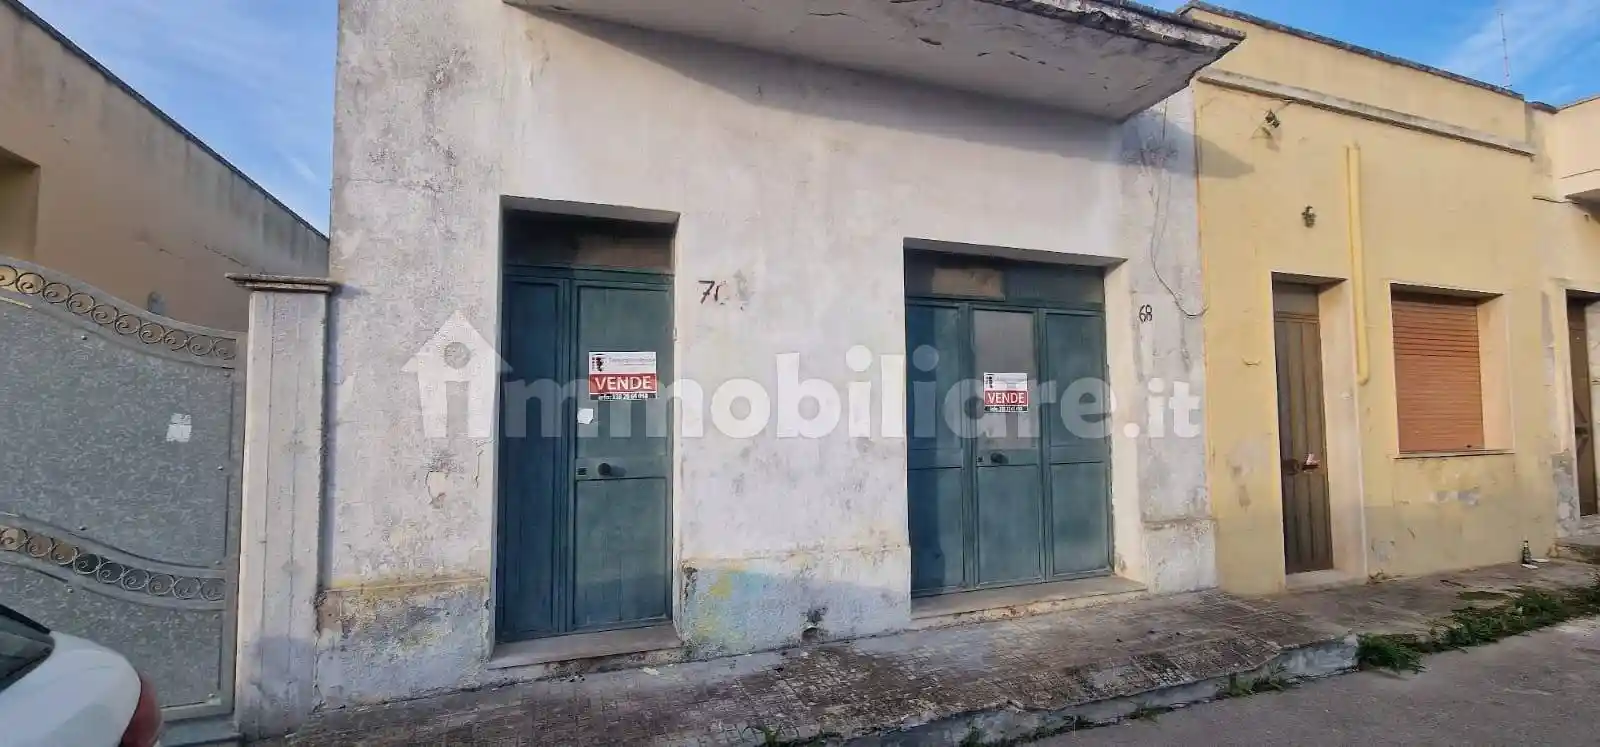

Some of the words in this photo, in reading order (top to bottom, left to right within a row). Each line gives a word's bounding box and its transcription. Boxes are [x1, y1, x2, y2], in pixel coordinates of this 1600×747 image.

[1139, 304, 1153, 323] 68
[594, 375, 653, 391] VENDE
[987, 392, 1025, 404] VENDE
